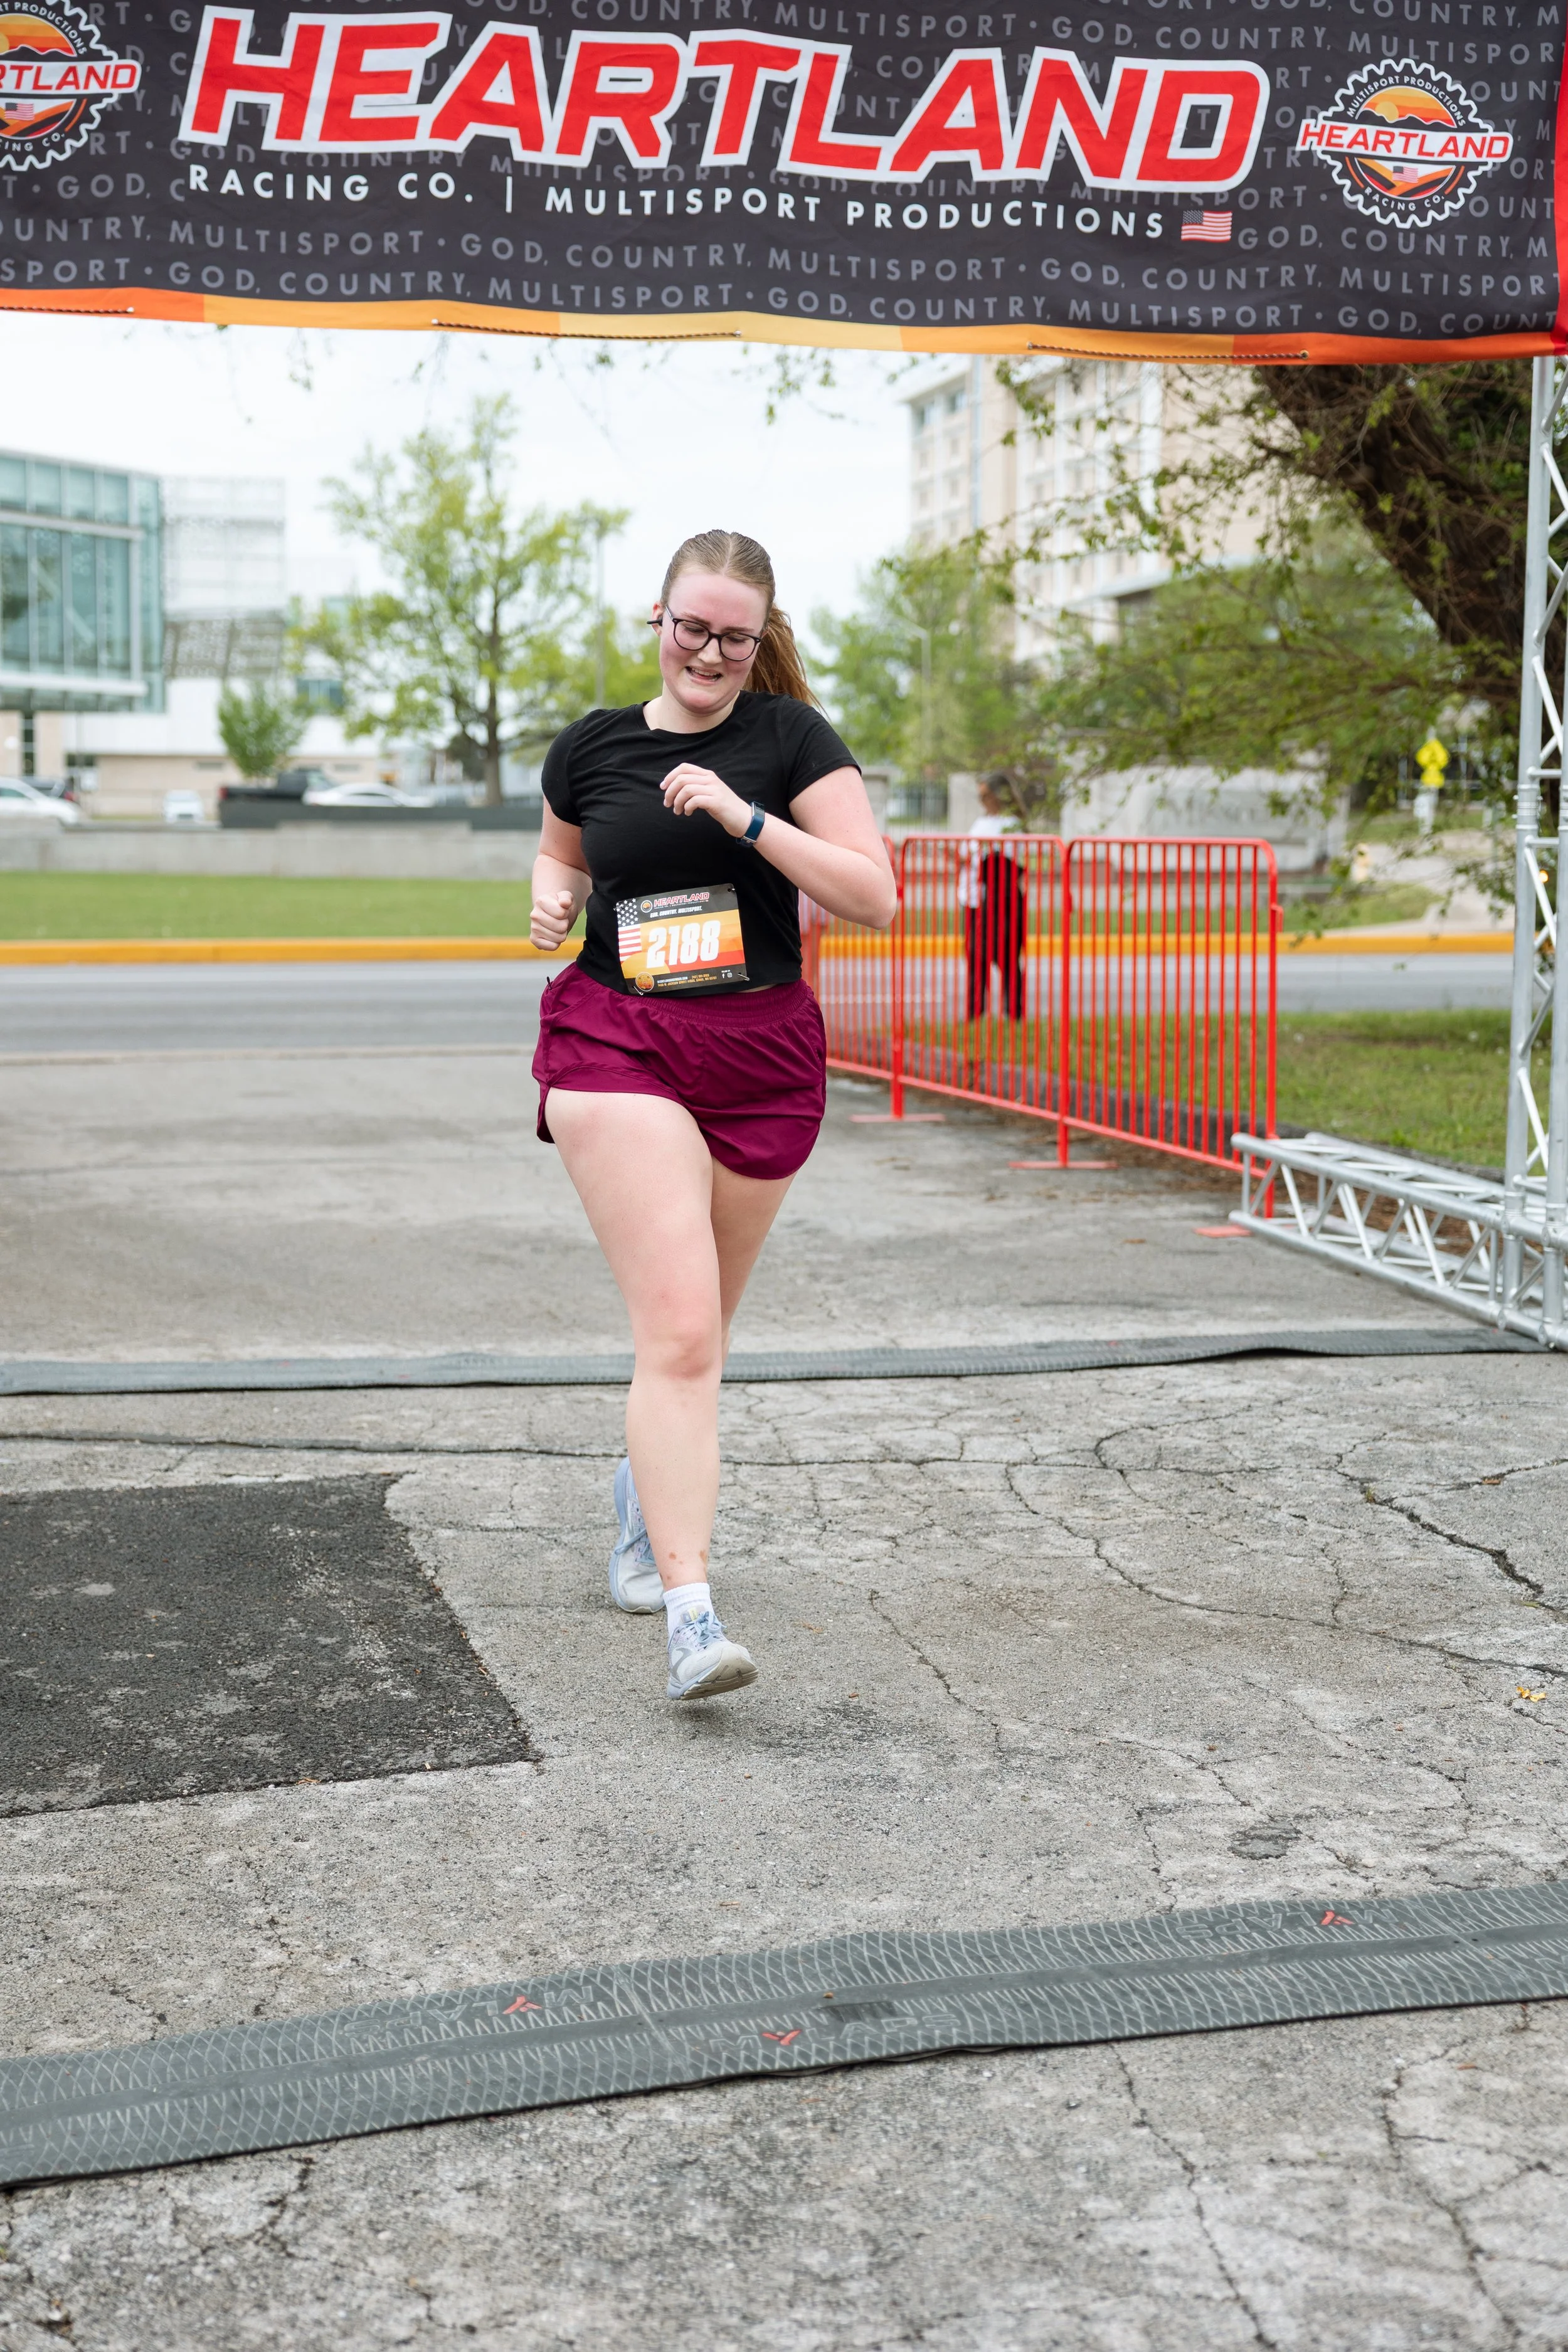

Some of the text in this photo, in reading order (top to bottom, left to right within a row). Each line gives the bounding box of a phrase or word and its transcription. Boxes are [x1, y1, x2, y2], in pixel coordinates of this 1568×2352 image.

[14, 2, 87, 55] PRODUCTIONS
[774, 3, 1016, 38] MULTISPORT
[1052, 16, 1137, 49] GOD,
[1155, 26, 1331, 51] COUNTRY,
[1348, 31, 1565, 64] MULTISPOR
[0, 63, 138, 91] TLAND
[178, 6, 1270, 192] HEARTLAND
[1346, 75, 1401, 118] MULTISPORT
[1403, 75, 1467, 127] PRODUCTIONS
[42, 132, 65, 147] CO.
[1301, 122, 1510, 159] HEARTLAND
[58, 172, 151, 199] GOD,
[189, 164, 369, 201] RACING
[398, 172, 473, 203] CO.
[545, 186, 820, 221] MULTISPORT
[847, 200, 1163, 238] PRODUCTIONS
[1364, 186, 1445, 211] RACING CO.
[0, 213, 152, 243] UNTRY,
[169, 220, 423, 255] MULTISPORT
[461, 233, 548, 266] GOD,
[566, 243, 751, 268] COUNTRY,
[768, 247, 1005, 282] MULTISPORT
[1041, 258, 1125, 289] GOD,
[1142, 264, 1322, 290] COUNTRY,
[1238, 225, 1323, 250] GOD,
[1341, 227, 1513, 259] COUNTRY,
[169, 262, 260, 294] GOD,
[279, 270, 470, 297] COUNTRY,
[488, 277, 733, 310] MULTISPORT
[768, 287, 854, 318] GOD,
[869, 295, 1051, 320] COUNTRY,
[1068, 299, 1303, 327] MULTISPORT
[1338, 305, 1422, 334] GOD,
[654, 892, 709, 908] HEARTLAND
[646, 919, 721, 968] 2188
